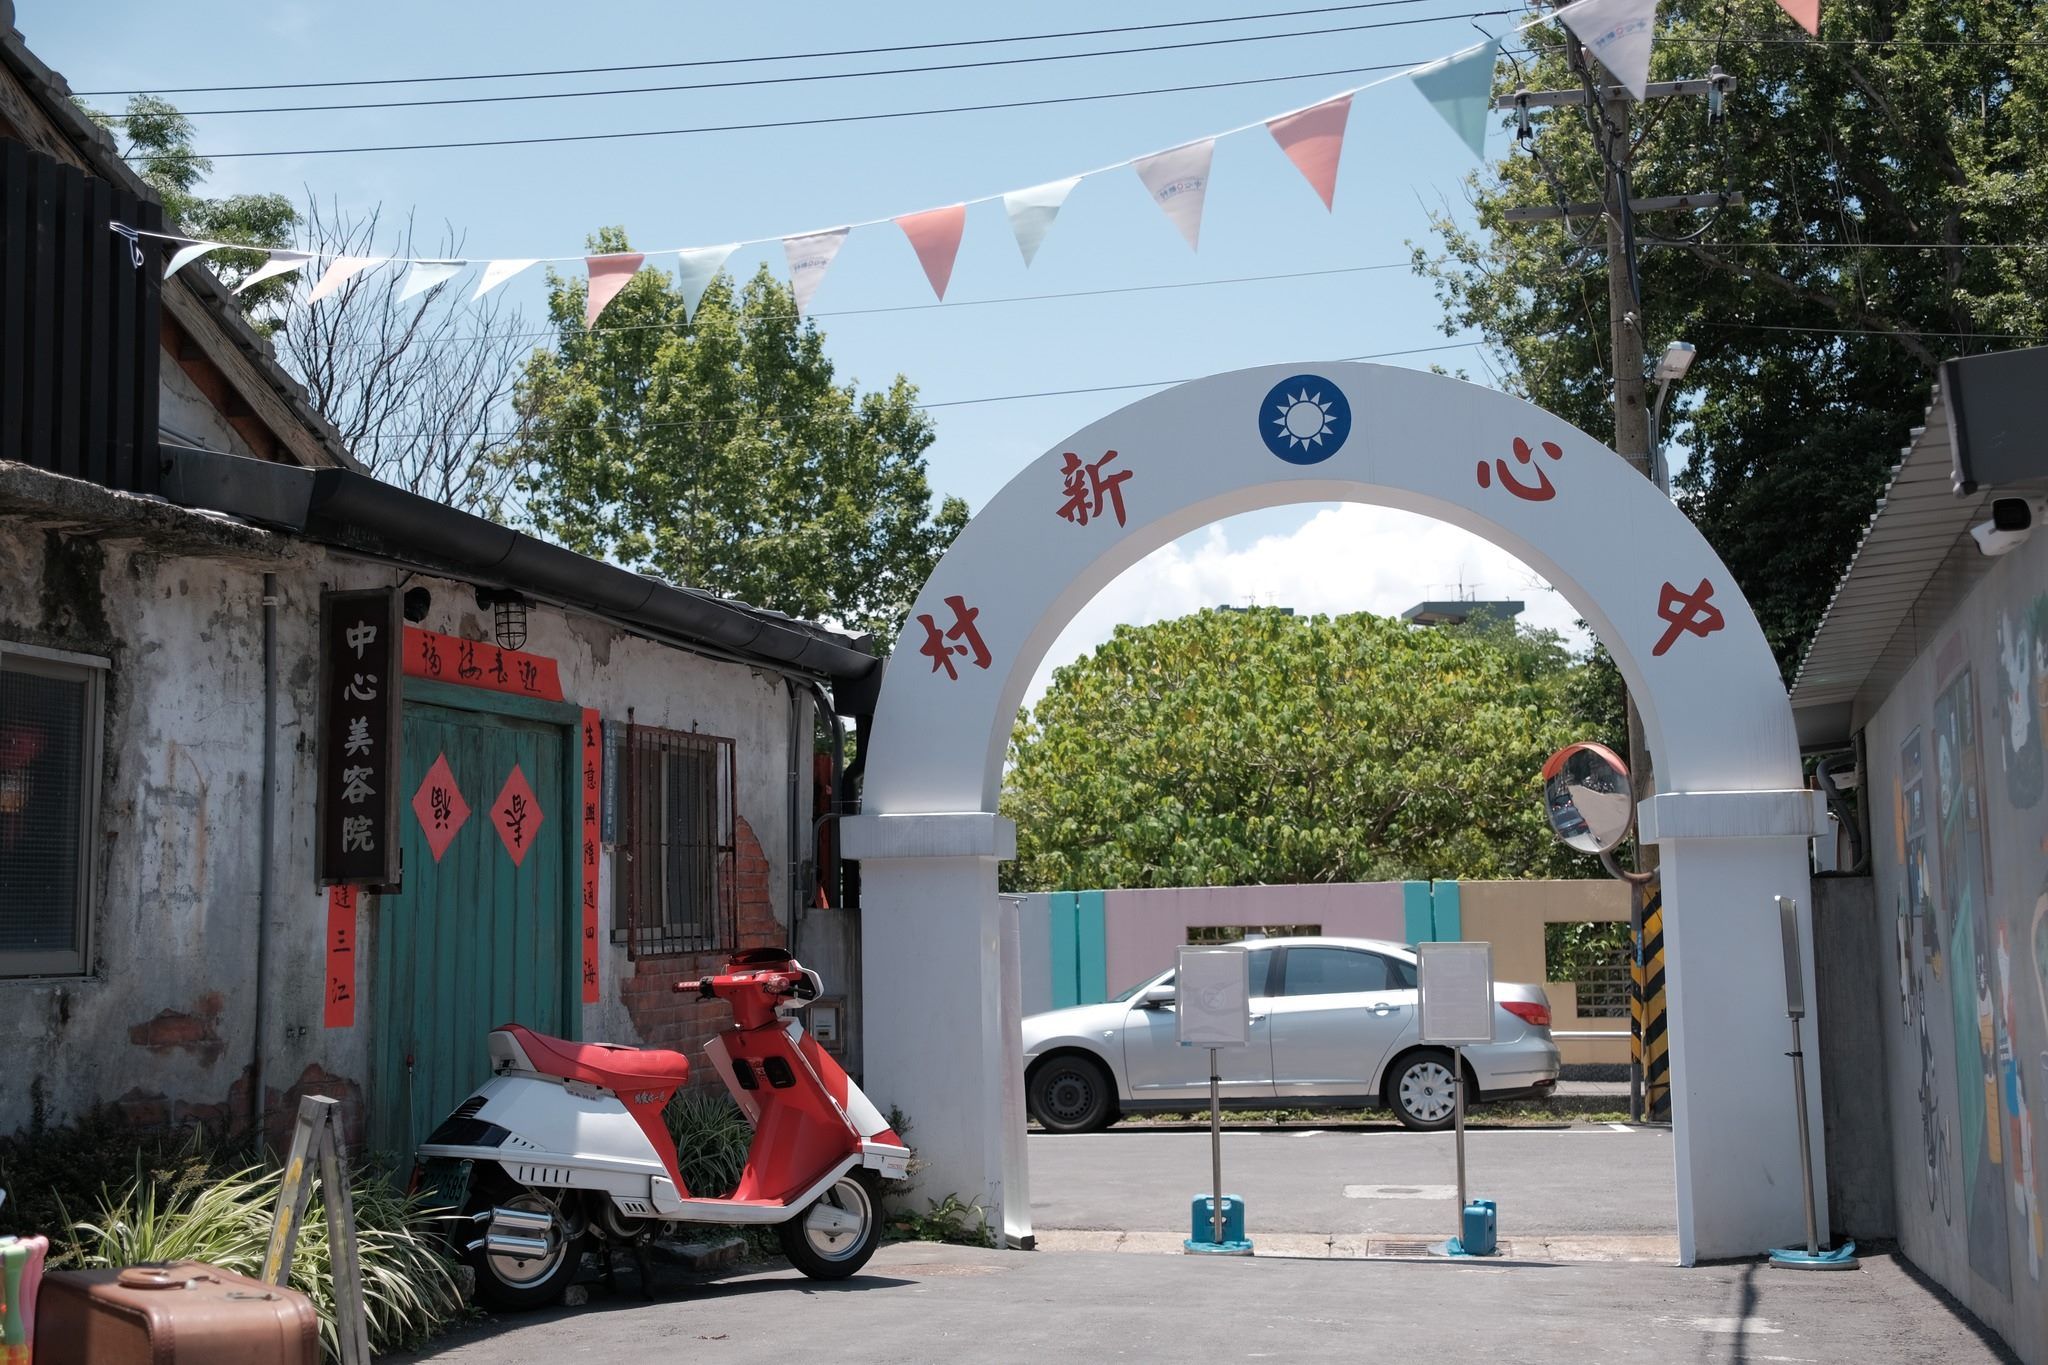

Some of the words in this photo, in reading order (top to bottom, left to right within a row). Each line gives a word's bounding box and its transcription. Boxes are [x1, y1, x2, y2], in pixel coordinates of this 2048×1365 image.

[341, 619, 378, 855] 中心美容院
[430, 785, 452, 831] 福
[504, 793, 528, 849] 春
